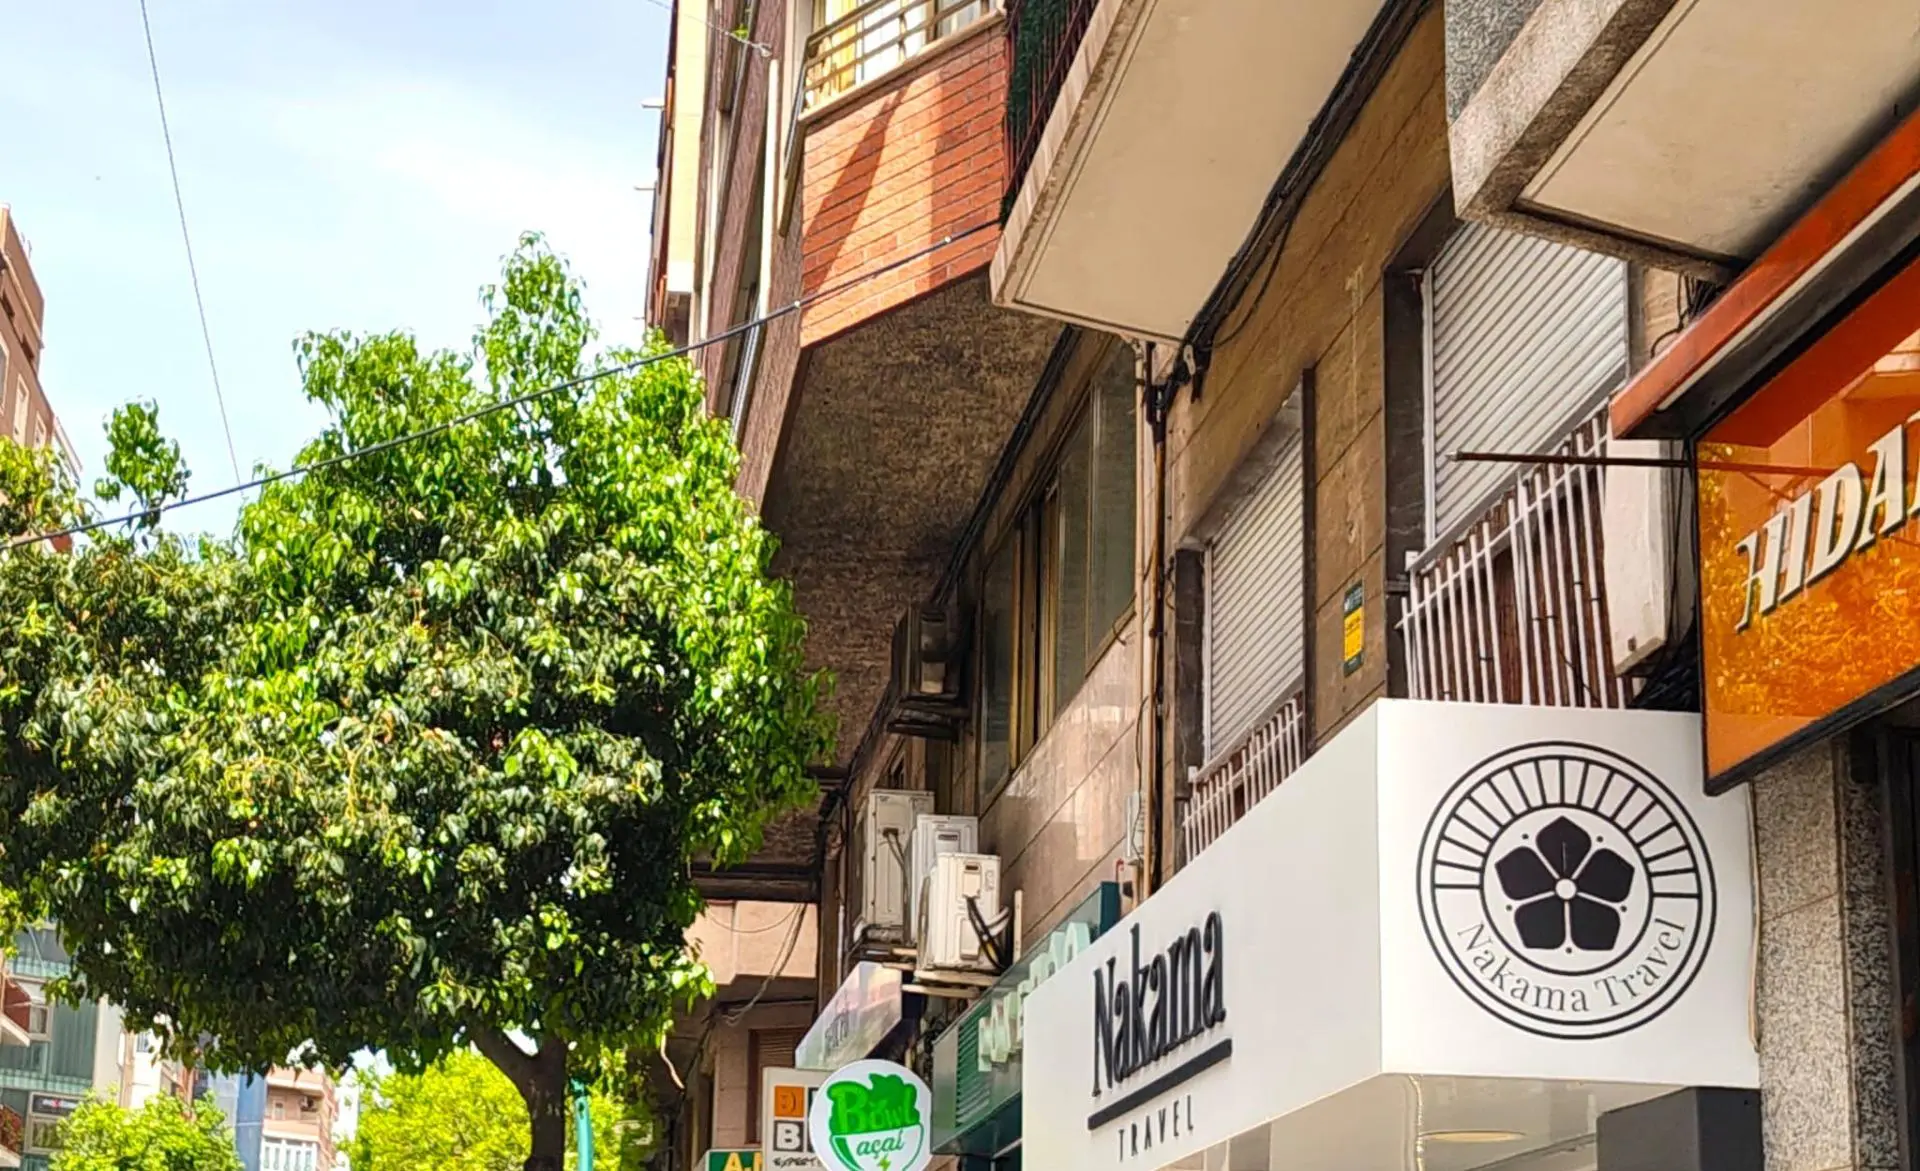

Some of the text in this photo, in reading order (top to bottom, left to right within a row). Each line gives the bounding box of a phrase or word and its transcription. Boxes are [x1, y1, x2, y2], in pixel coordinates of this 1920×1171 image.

[1092, 911, 1226, 1096] Nakama
[1457, 916, 1687, 1012] Nakama Travel
[829, 1084, 914, 1132] Bowl
[1118, 1094, 1194, 1162] TRAVEL
